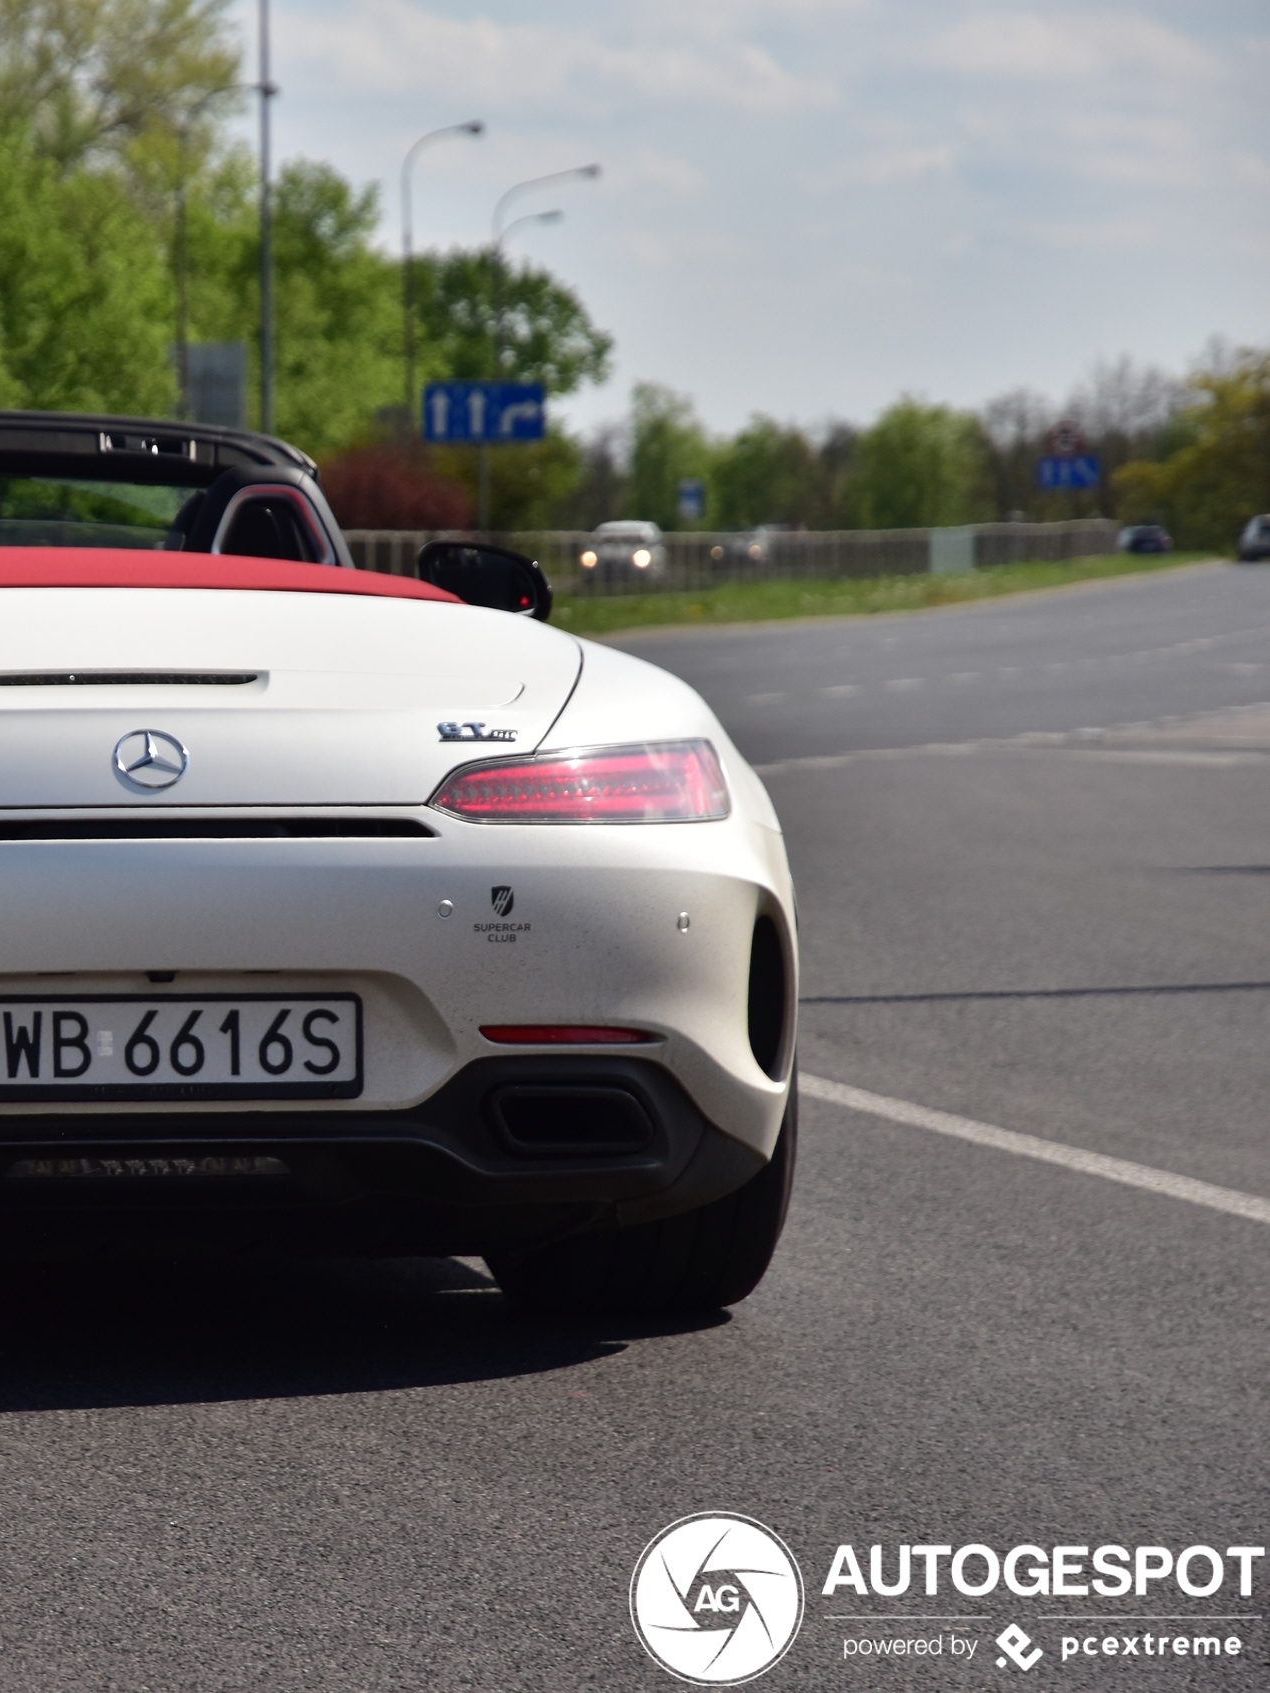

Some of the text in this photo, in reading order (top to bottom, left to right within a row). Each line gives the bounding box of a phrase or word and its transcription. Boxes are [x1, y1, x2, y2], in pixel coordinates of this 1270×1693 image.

[473, 922, 531, 932] SUPERCAR
[487, 933, 517, 942] CLUB
[2, 1008, 341, 1078] WB 6616S
